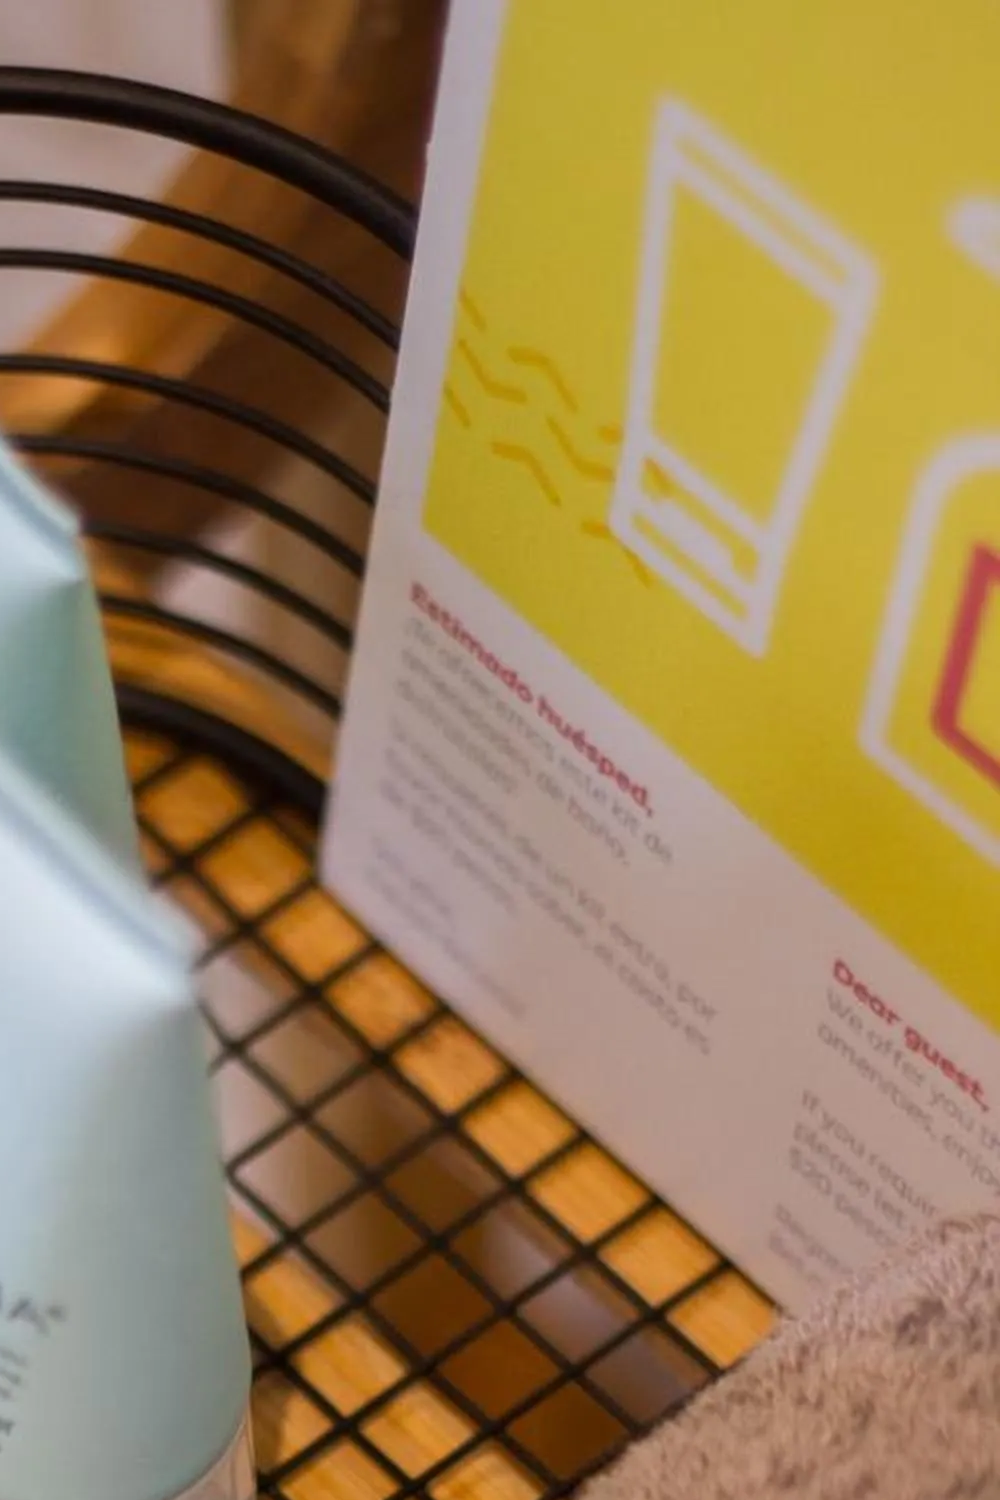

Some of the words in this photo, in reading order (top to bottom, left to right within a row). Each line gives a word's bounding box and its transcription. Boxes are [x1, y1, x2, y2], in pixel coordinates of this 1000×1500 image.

[410, 581, 534, 704] Estimado
[536, 694, 655, 818] huésped,
[833, 958, 901, 1026] Dear
[903, 1025, 990, 1113] guest,
